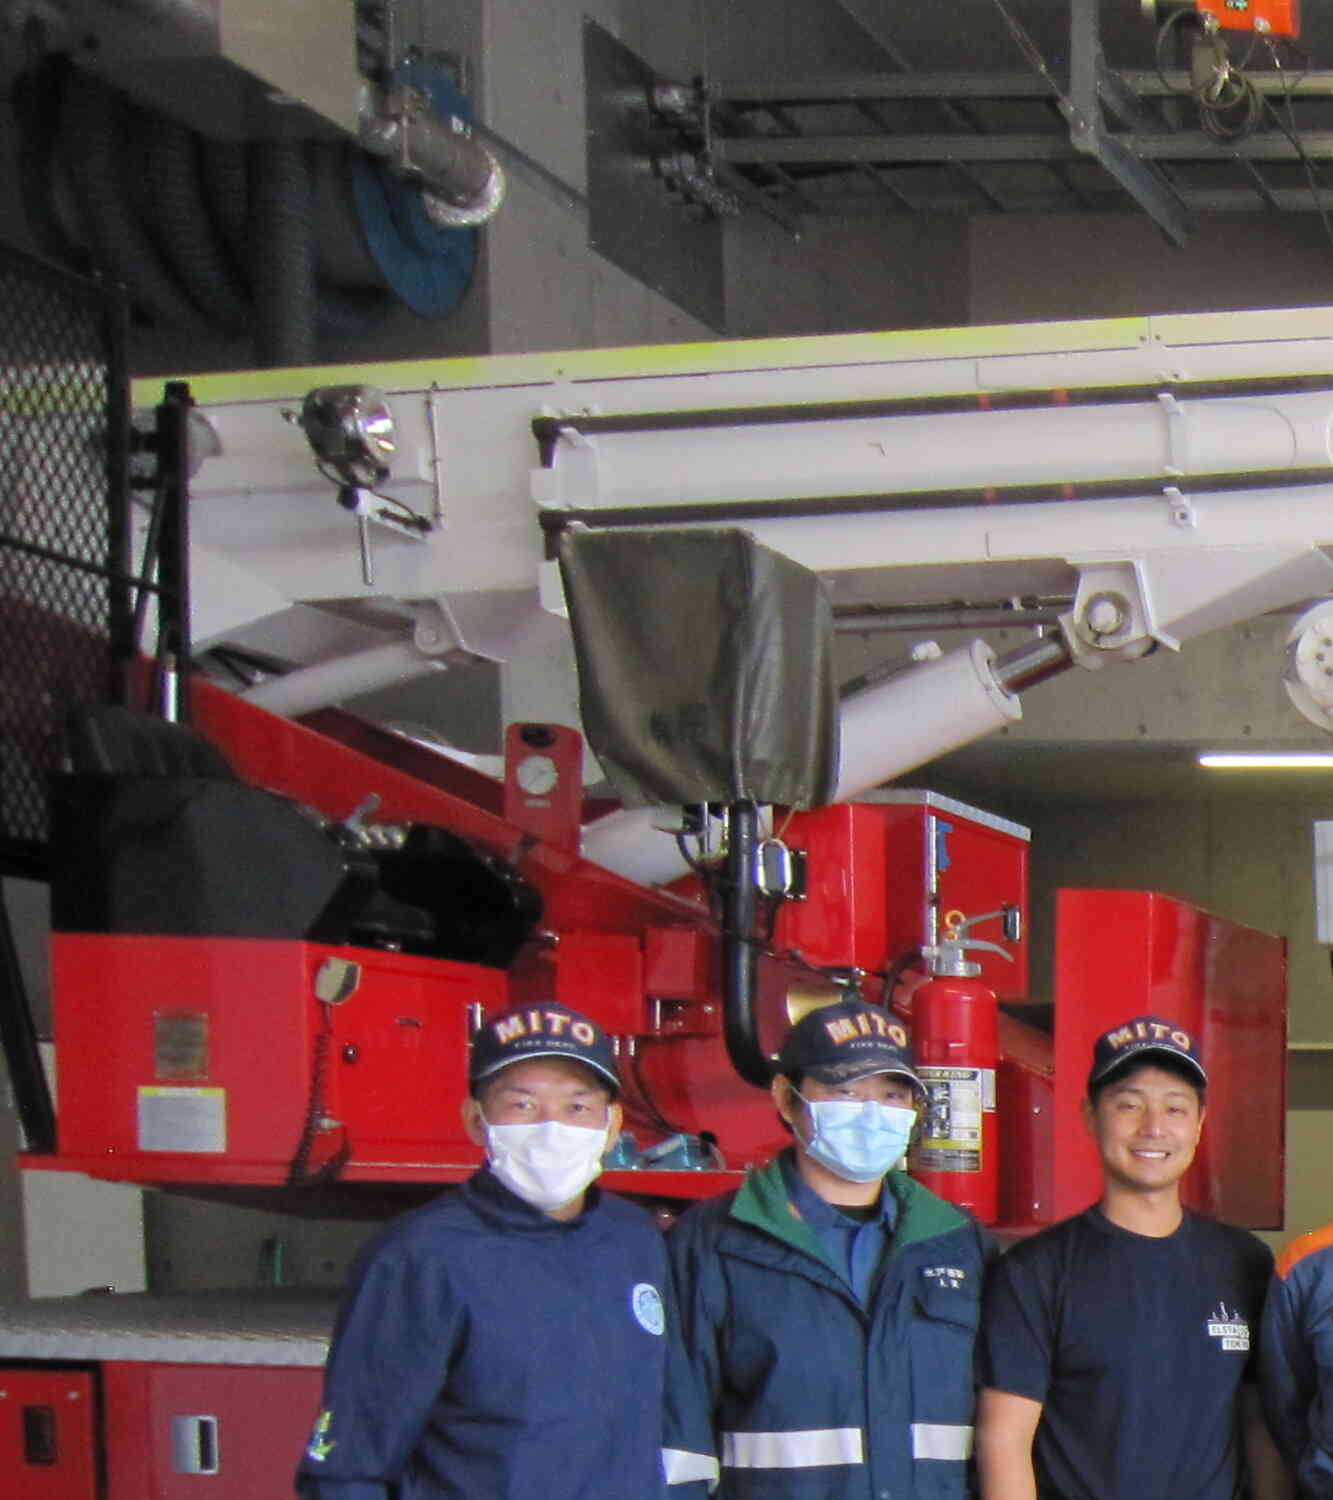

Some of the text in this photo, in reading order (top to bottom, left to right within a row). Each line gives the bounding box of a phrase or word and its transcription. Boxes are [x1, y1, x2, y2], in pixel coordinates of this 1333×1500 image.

[494, 1009, 596, 1047] MITO
[824, 1010, 908, 1047] MITO
[1107, 1021, 1192, 1053] MITO
